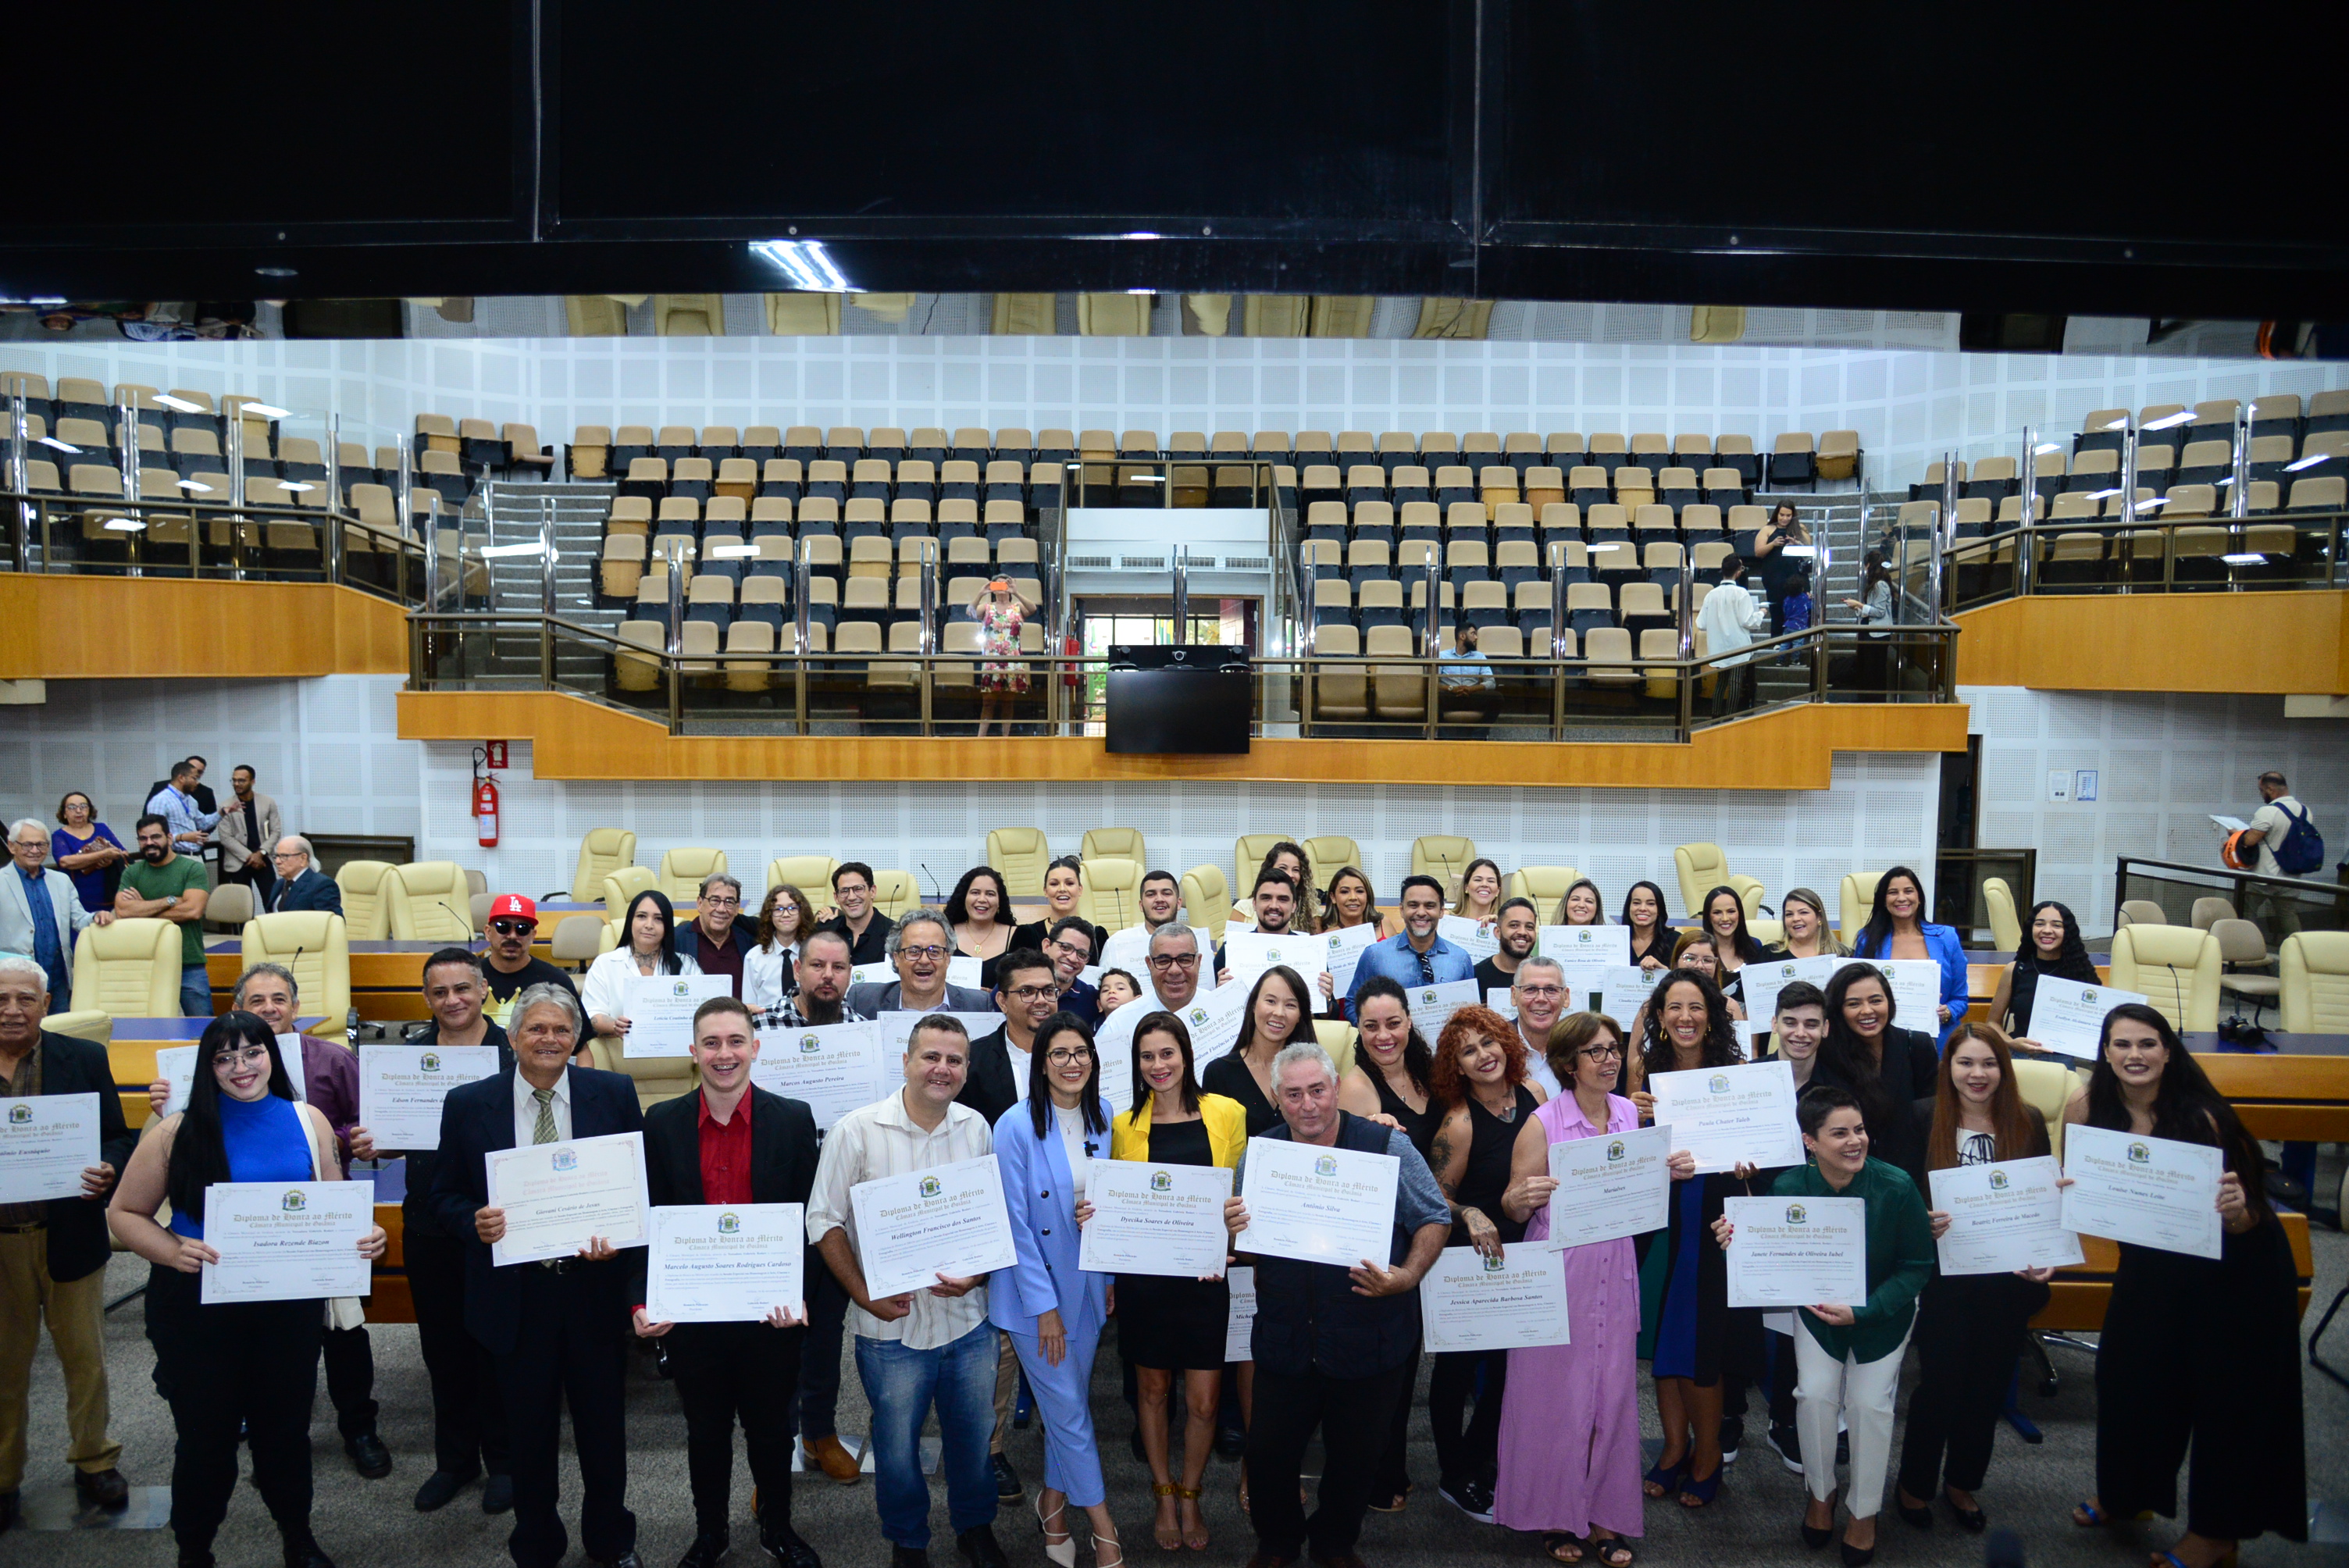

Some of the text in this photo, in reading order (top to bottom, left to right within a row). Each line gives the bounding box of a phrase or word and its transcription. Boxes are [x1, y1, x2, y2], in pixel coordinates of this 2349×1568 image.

[509, 896, 522, 912] LA
[1199, 1021, 1217, 1034] Honra
[1225, 1004, 1245, 1020] Mérito
[1209, 1039, 1229, 1053] Florêncio
[1714, 1093, 1737, 1103] Honra
[12, 1124, 37, 1133] Honra
[1571, 1167, 1598, 1176] Diploma
[1608, 1162, 1627, 1171] Honra
[1638, 1156, 1656, 1165] Mérito
[1271, 1171, 1303, 1181] Diploma
[1317, 1177, 1339, 1187] Honra
[1353, 1182, 1378, 1192] Mérito
[880, 1206, 912, 1217] Diploma
[924, 1198, 947, 1207] Honra
[961, 1189, 984, 1200] Mérito
[1109, 1190, 1139, 1199] Diploma
[1152, 1192, 1174, 1201] Honra
[1187, 1195, 1211, 1203] Mérito
[918, 1206, 943, 1217] Municipal
[892, 1231, 921, 1240] Wellington
[924, 1224, 950, 1234] Francisco
[1523, 1270, 1546, 1278] Mérito
